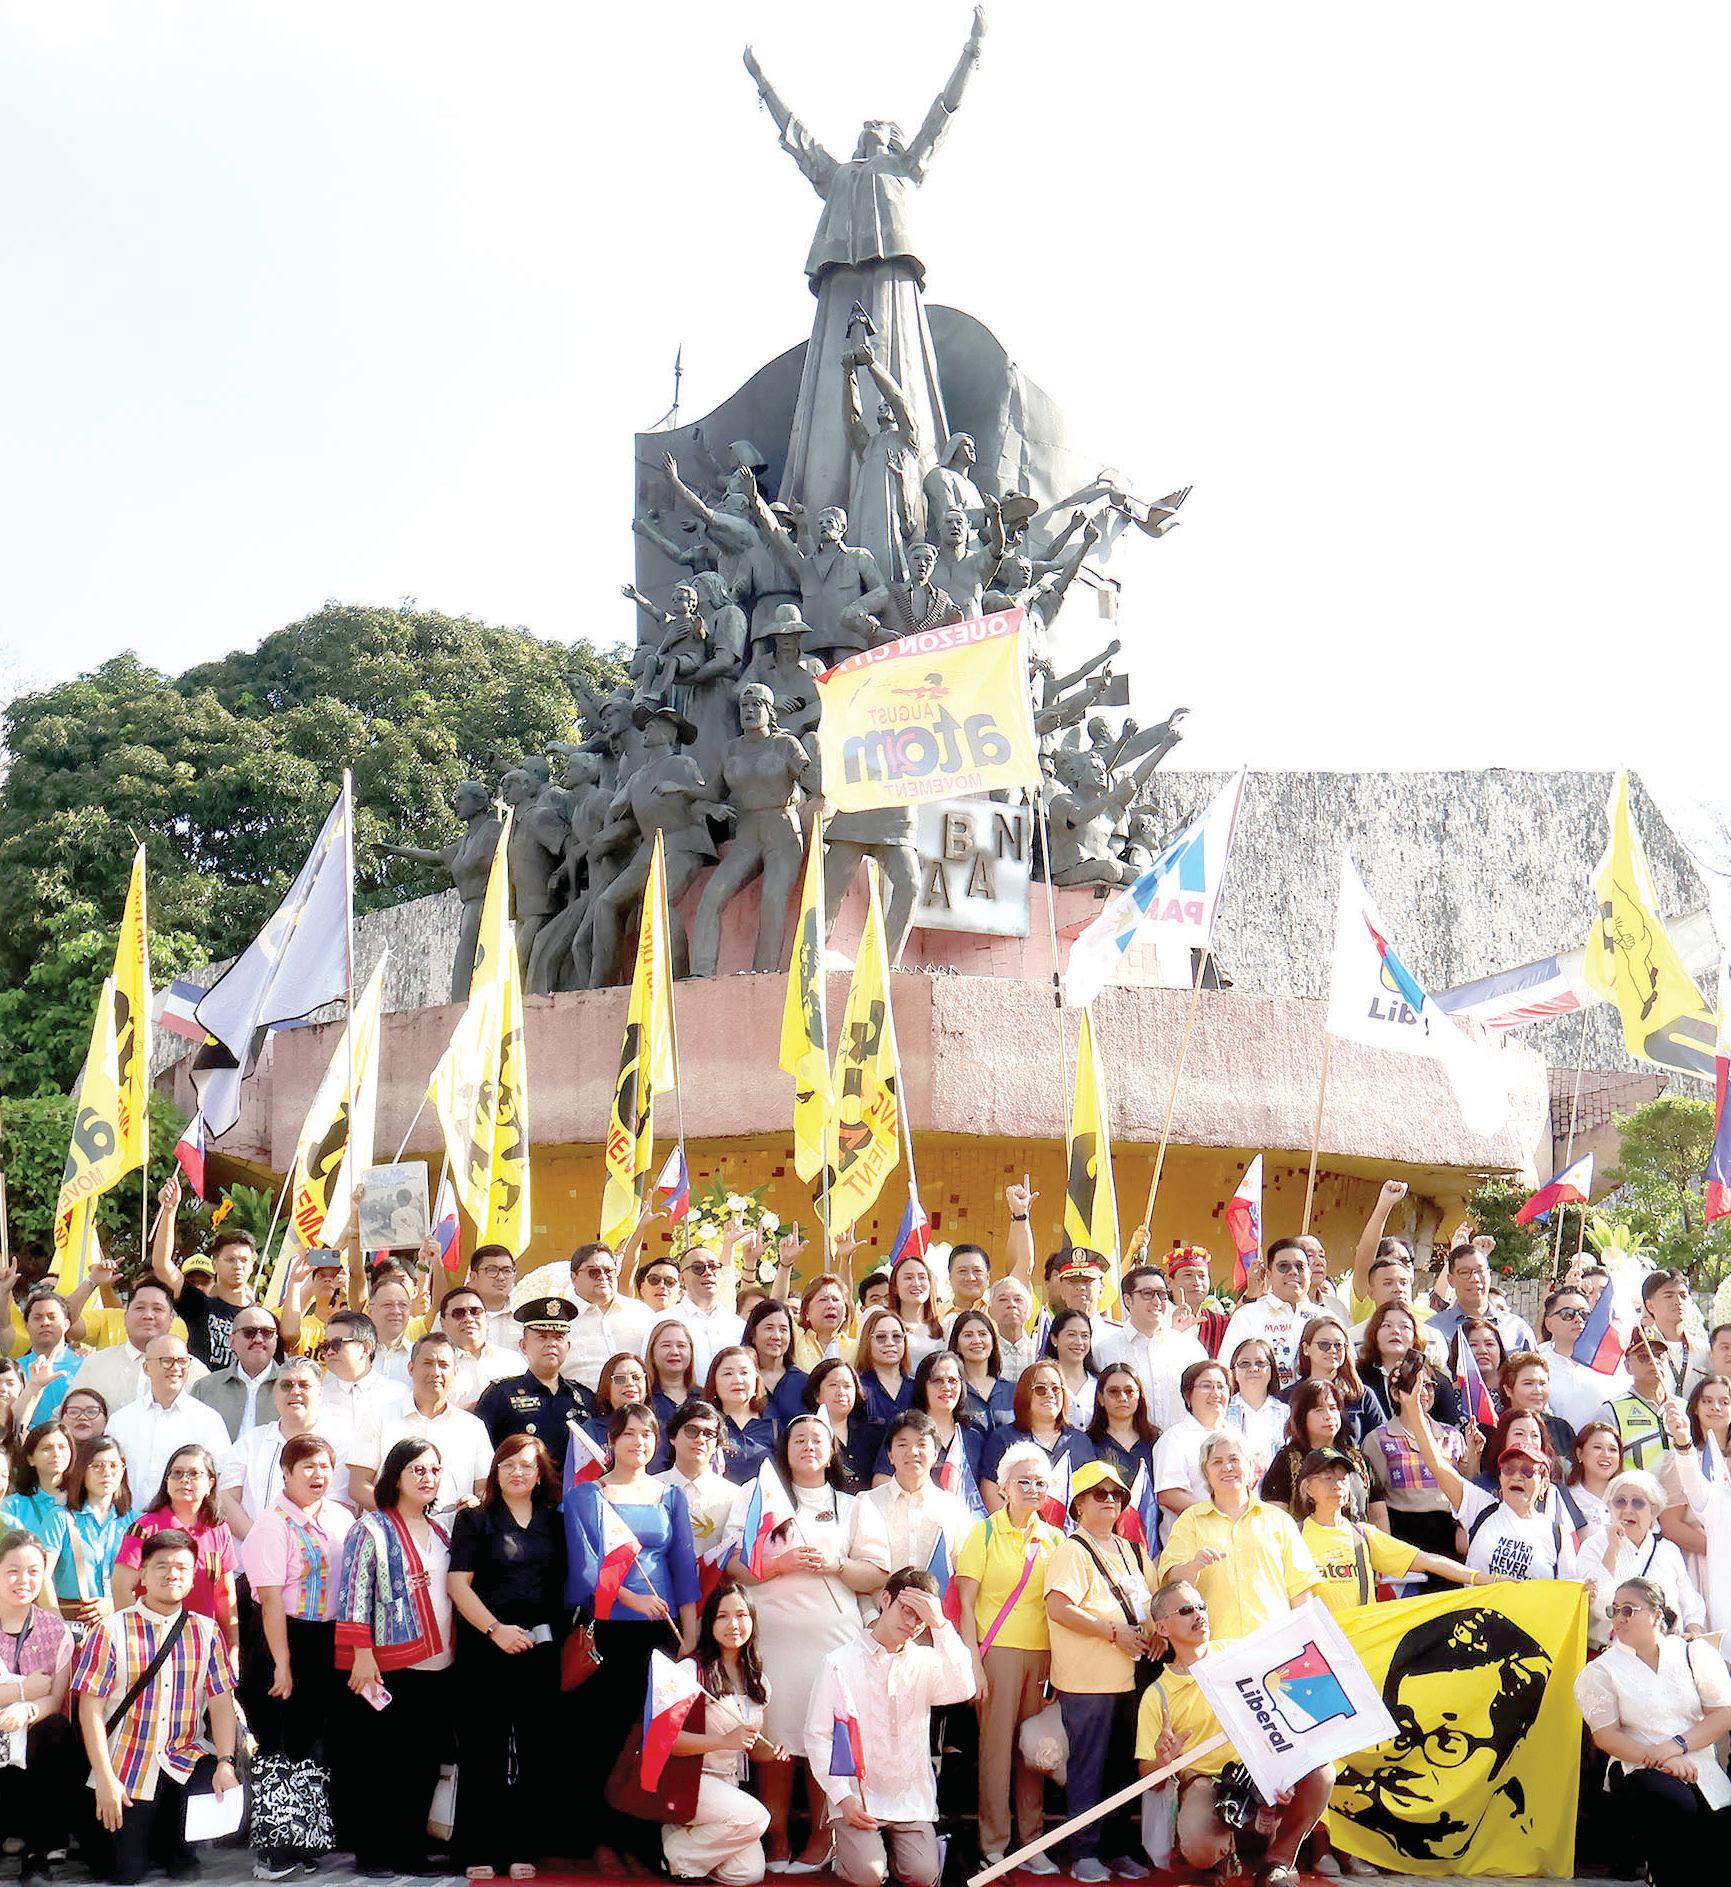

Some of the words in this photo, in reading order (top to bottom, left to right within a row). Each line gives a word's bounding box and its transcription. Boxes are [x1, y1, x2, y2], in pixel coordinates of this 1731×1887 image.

[1368, 997, 1422, 1027] Lib
[1493, 1545, 1533, 1566] AGAIN!
[1498, 1536, 1533, 1553] NEVER
[1491, 1554, 1528, 1576] NEVER
[1235, 1677, 1294, 1753] Liberal
